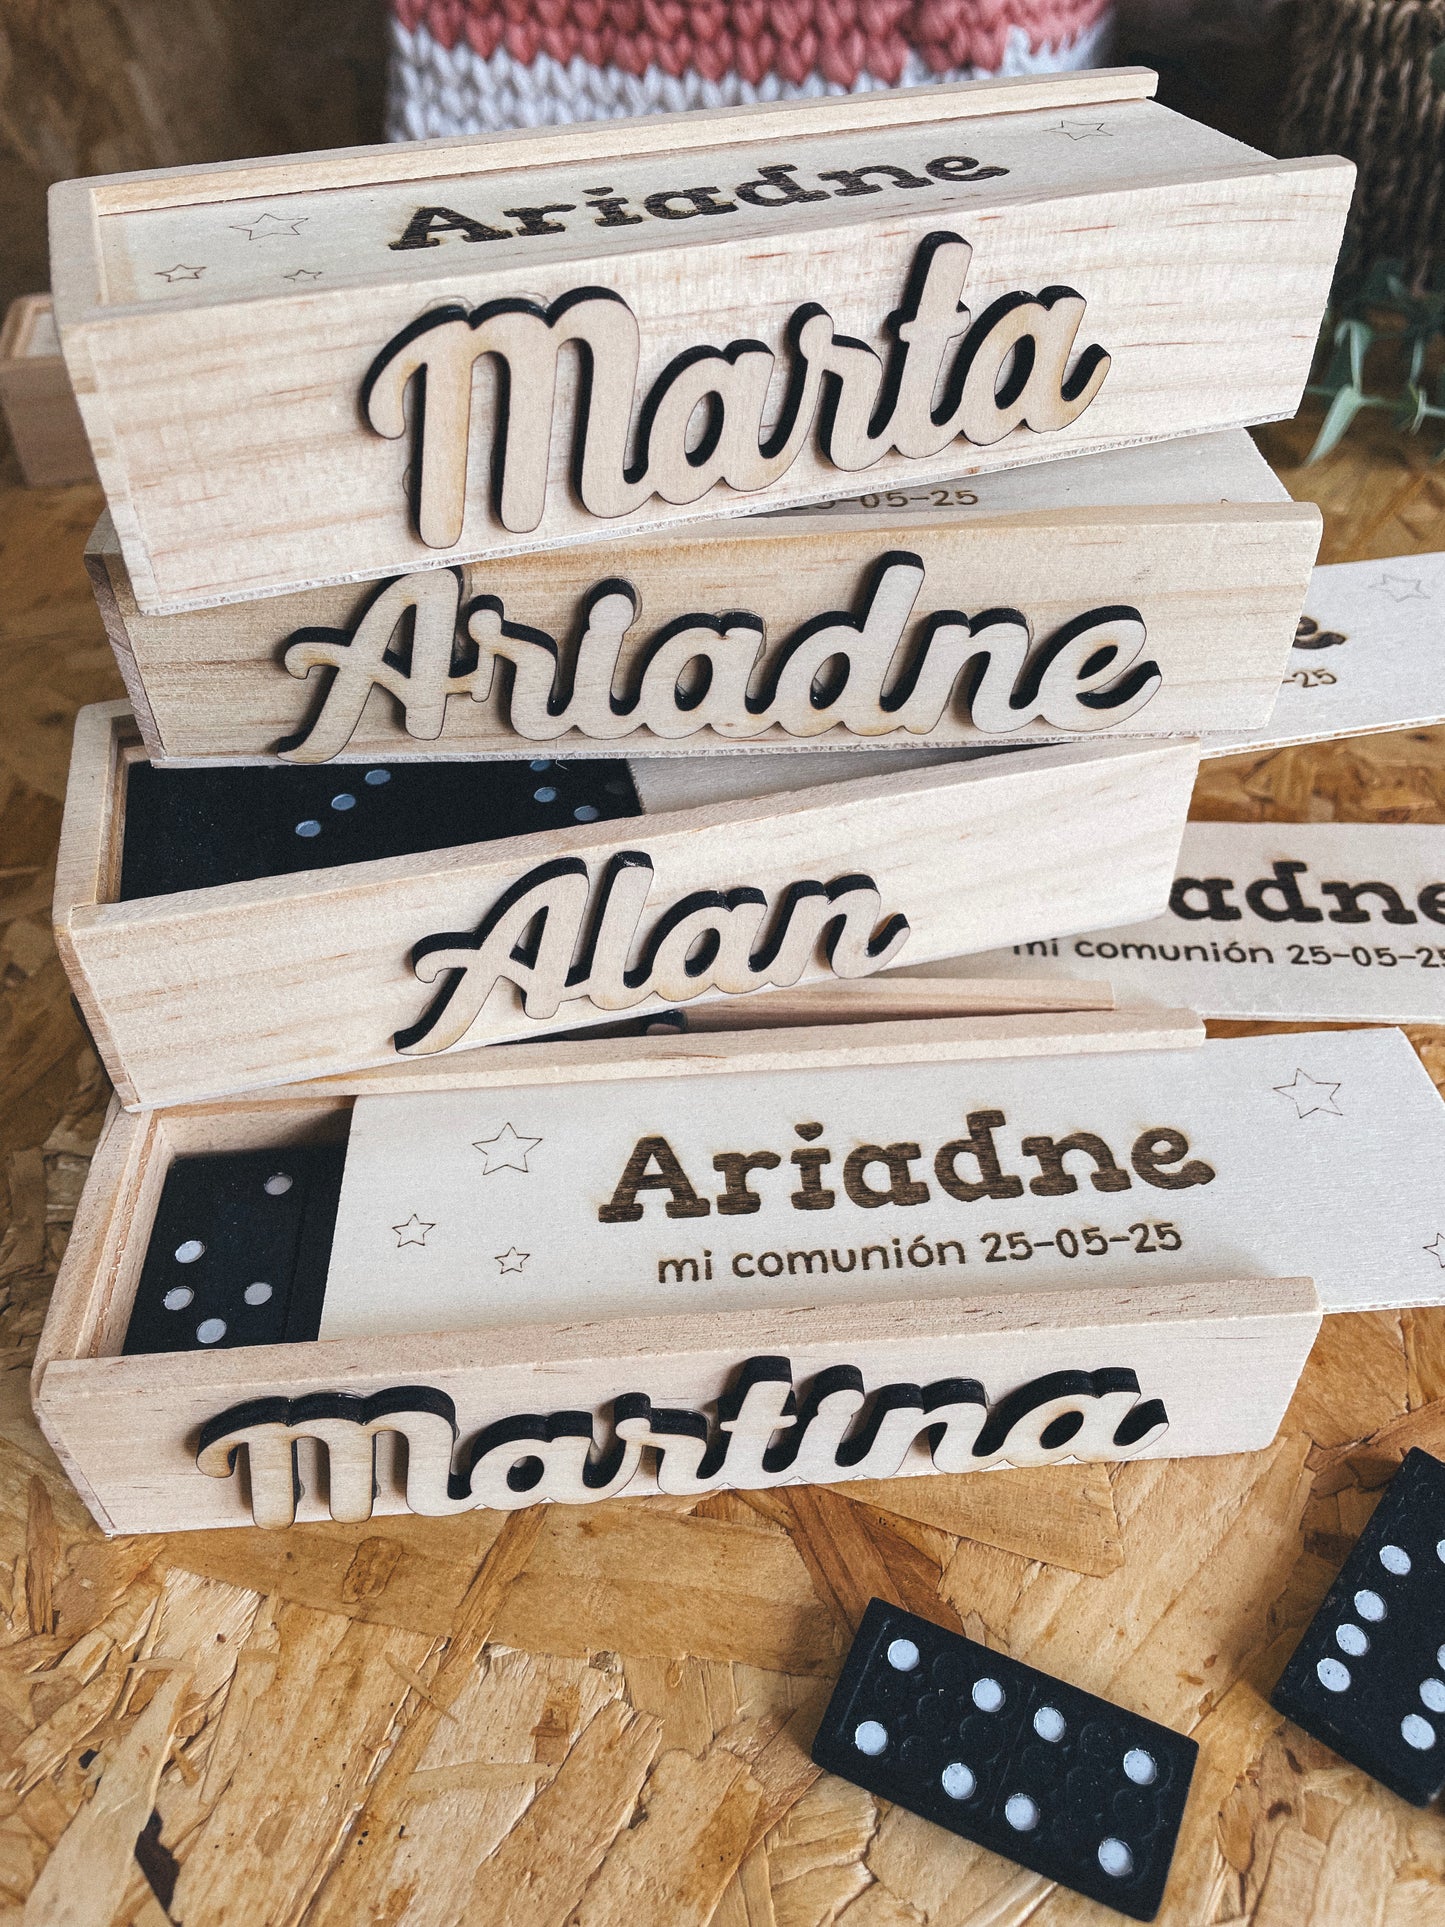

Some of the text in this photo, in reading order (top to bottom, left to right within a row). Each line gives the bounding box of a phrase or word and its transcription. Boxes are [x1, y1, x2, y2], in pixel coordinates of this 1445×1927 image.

[388, 155, 1010, 250] Ariadne
[361, 230, 1111, 550] Marta
[276, 550, 1162, 764] Ariadne
[394, 851, 910, 1055] Alan
[1074, 940, 1274, 963] comunión
[598, 1109, 1216, 1222] Ariadne
[658, 1222, 1183, 1283] mi comunión 25-05-25
[196, 1355, 1169, 1529] Martina
